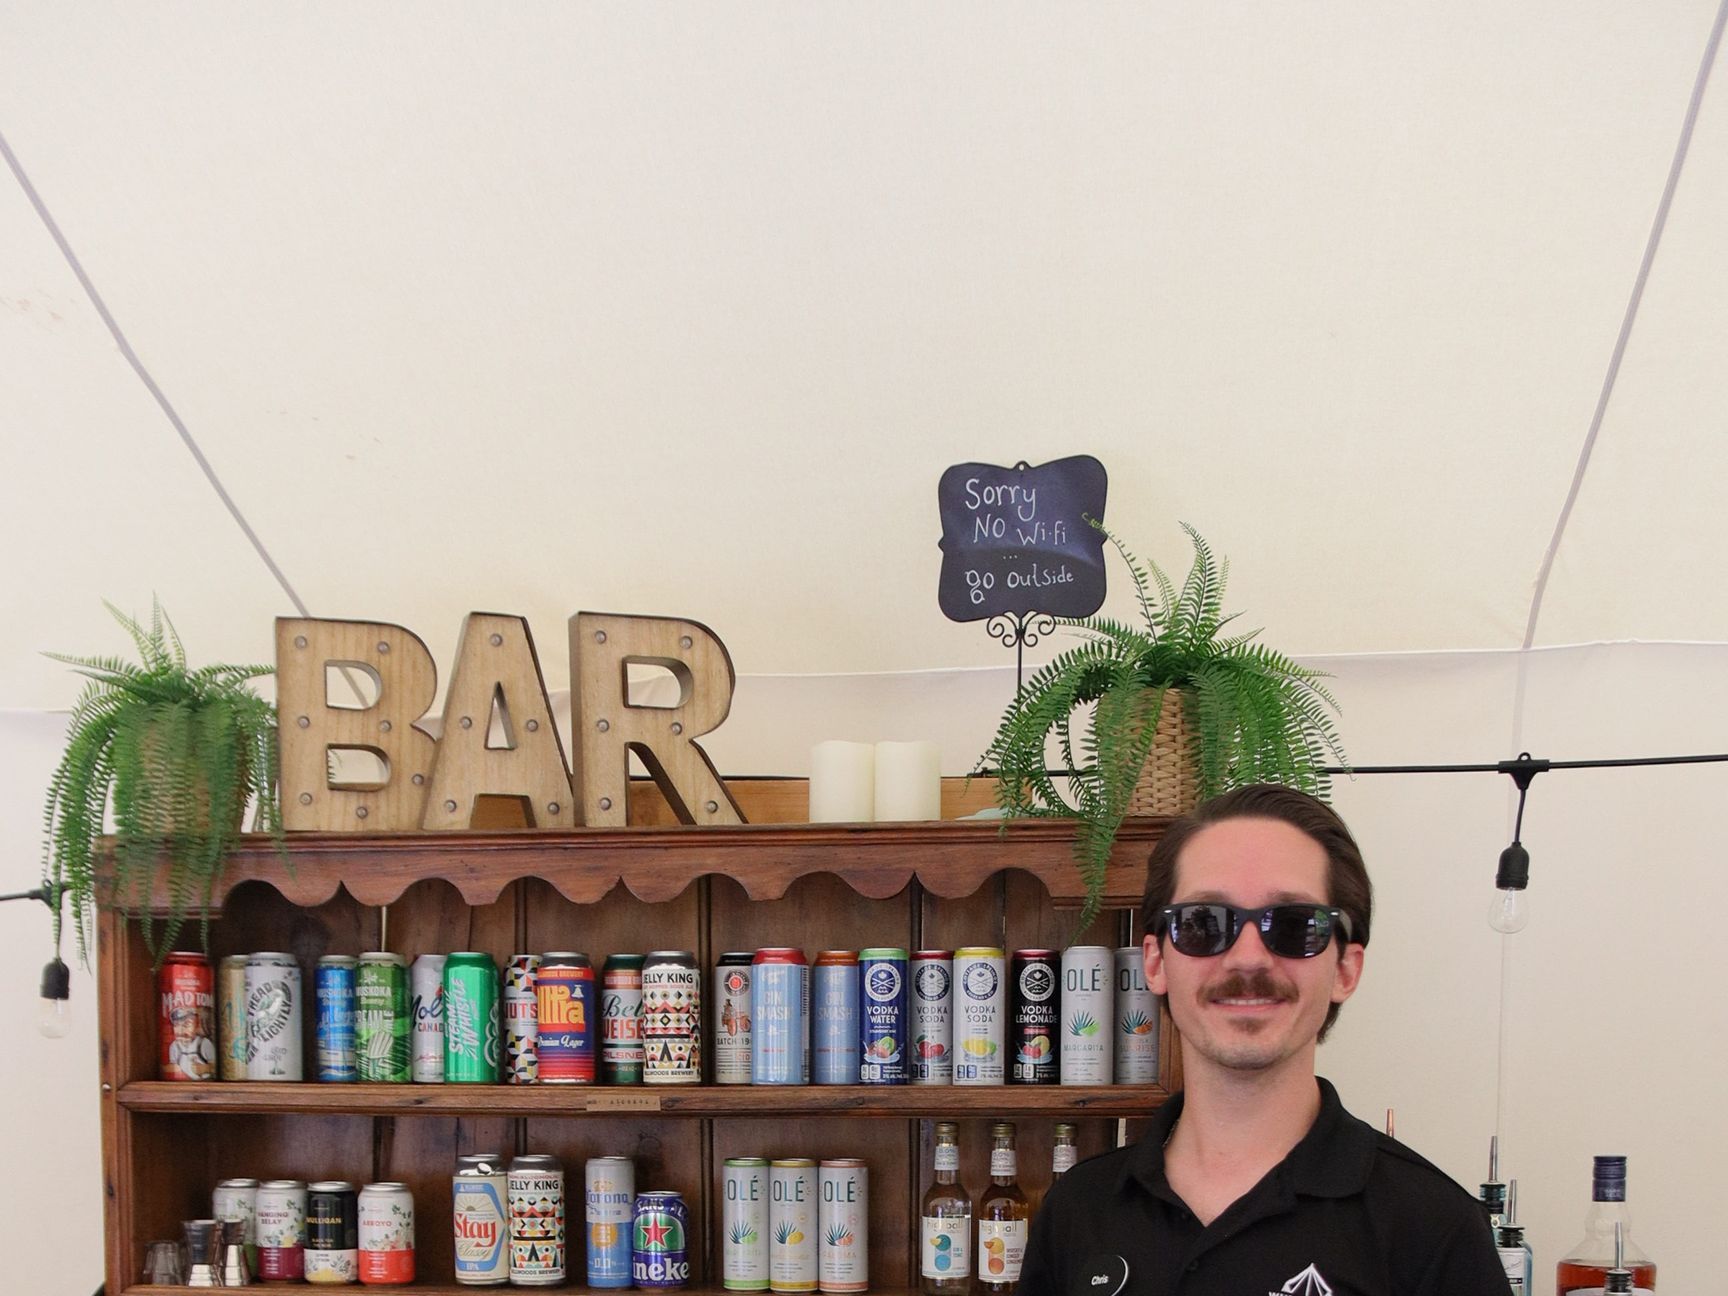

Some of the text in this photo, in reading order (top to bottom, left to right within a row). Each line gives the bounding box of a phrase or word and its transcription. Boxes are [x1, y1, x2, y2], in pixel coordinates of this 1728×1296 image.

[965, 478, 1037, 522] Sorry
[973, 514, 1006, 543] NO
[965, 569, 995, 604] go
[275, 611, 749, 831] BAR
[644, 973, 664, 984] ELLY
[667, 973, 694, 984] KING
[1066, 963, 1102, 992] OLÉ
[866, 1005, 899, 1015] VODKA
[916, 1006, 948, 1015] VODKA
[964, 1005, 996, 1014] VODKA
[1021, 1005, 1053, 1015] VODKA
[869, 1015, 897, 1024] WATER
[919, 1014, 945, 1024] SODA
[966, 1014, 993, 1023] SODA
[417, 1022, 444, 1033] CANAD
[603, 1049, 645, 1060] PILSNE
[510, 1179, 560, 1191] ELLY KING
[727, 1174, 759, 1201] OLÉ
[773, 1175, 804, 1202] OLÉ
[823, 1176, 856, 1203] OLÉ
[454, 1212, 497, 1248] Stay
